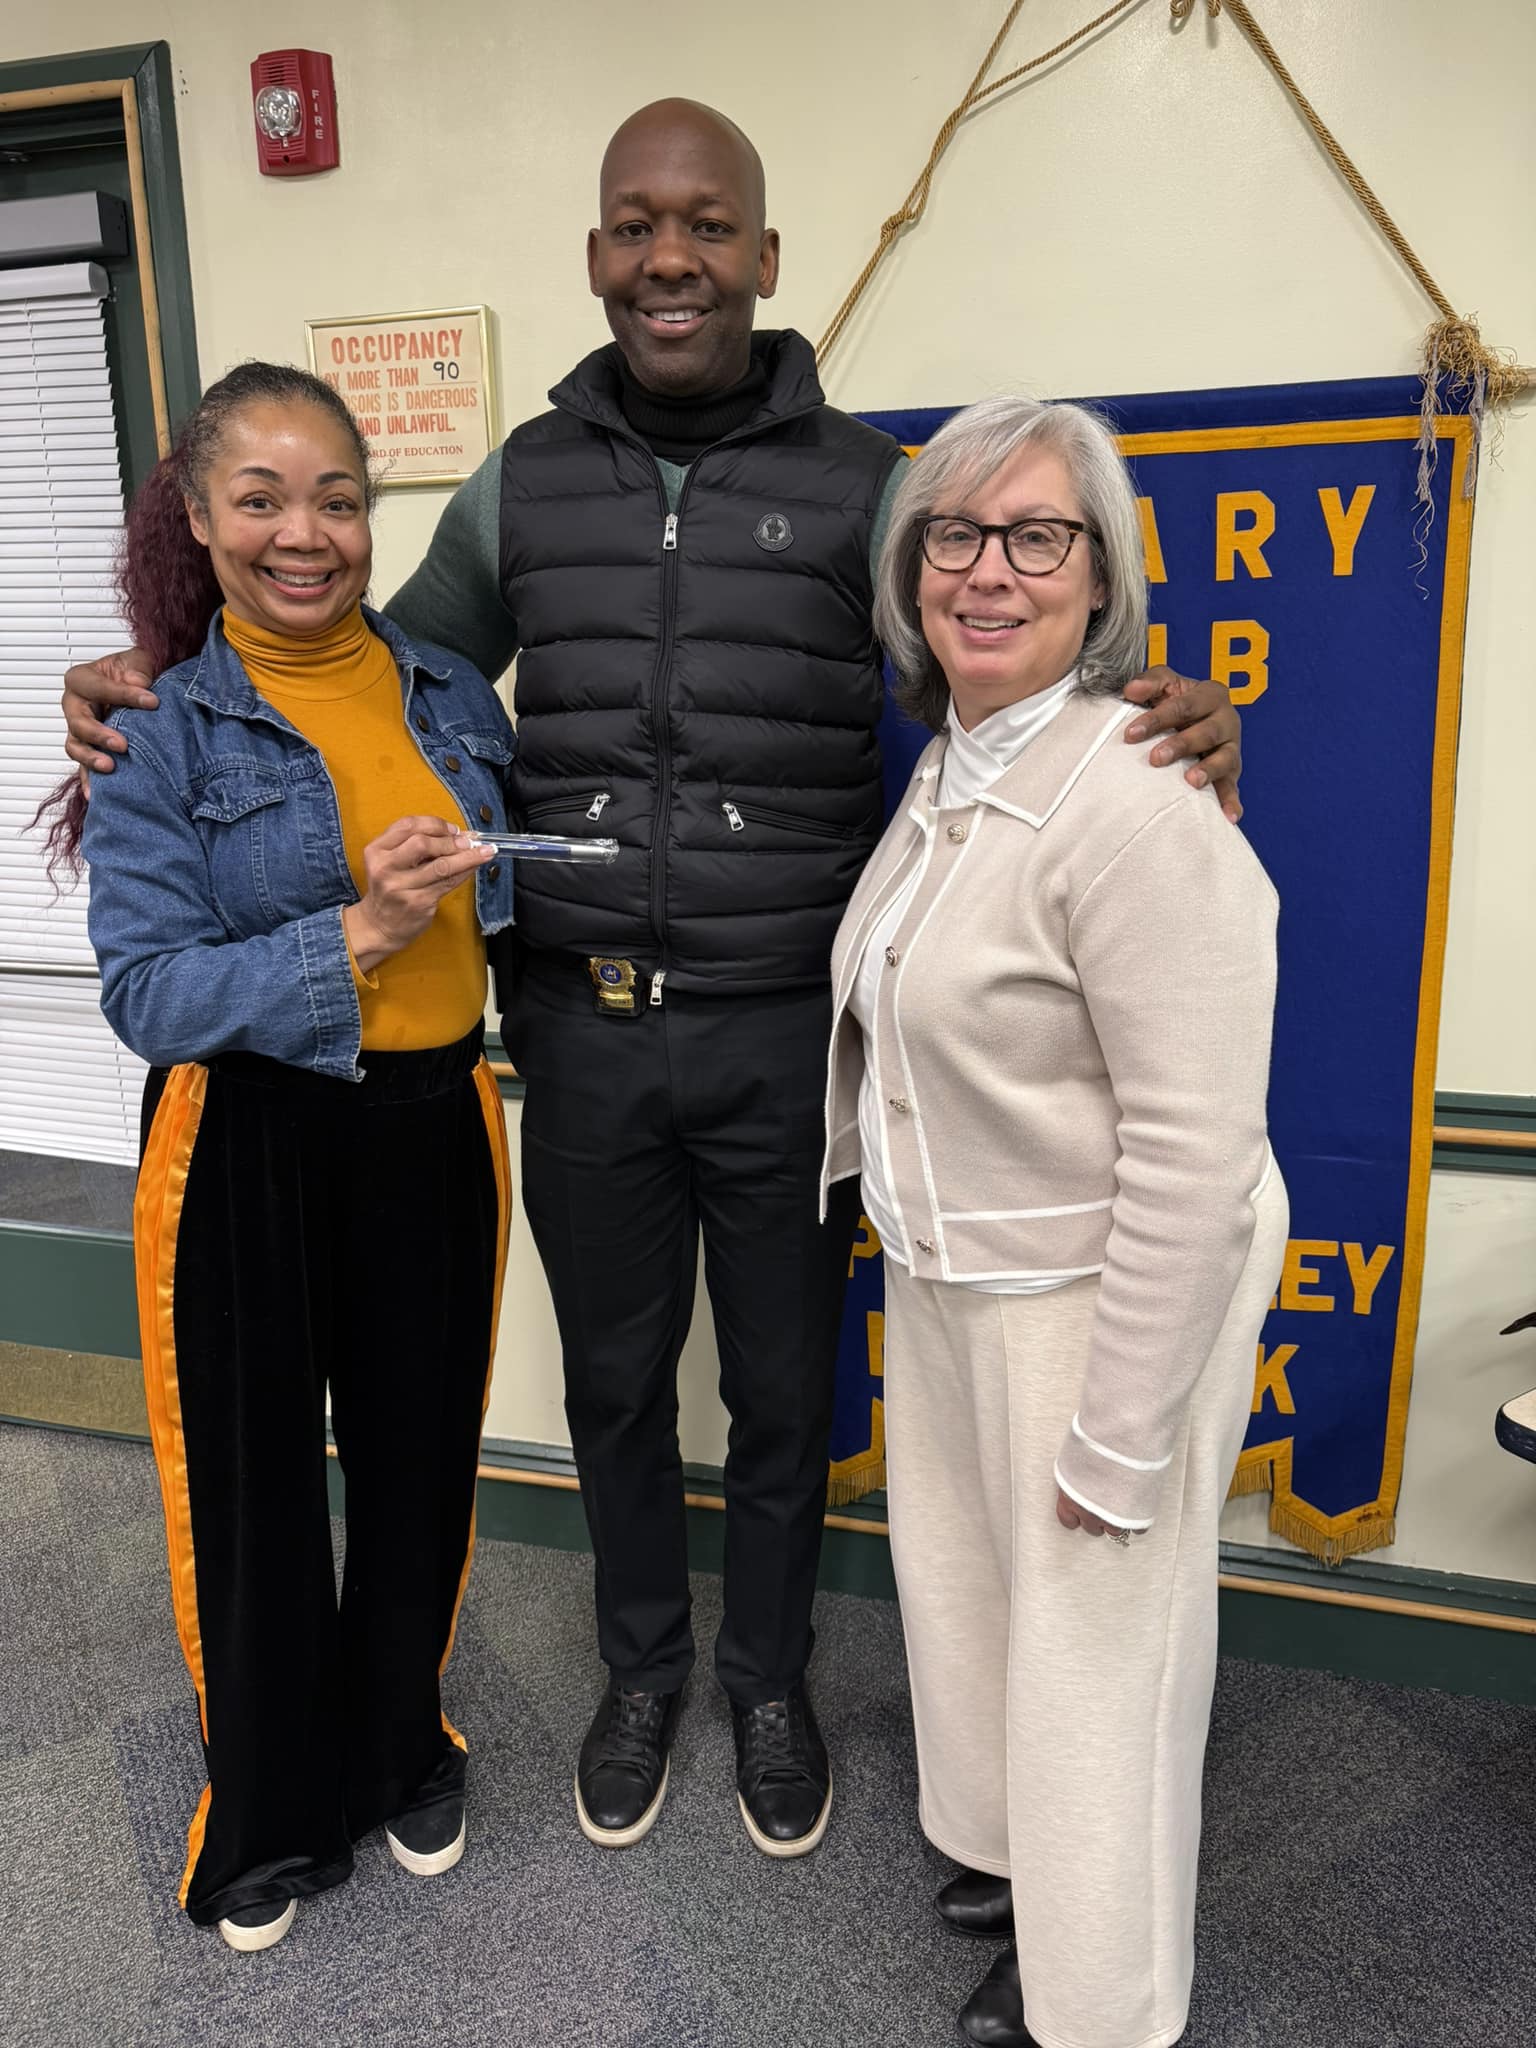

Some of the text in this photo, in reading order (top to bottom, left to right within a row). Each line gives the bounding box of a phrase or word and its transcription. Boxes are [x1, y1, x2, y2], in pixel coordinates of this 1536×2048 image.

[311, 89, 324, 140] FIRE
[331, 328, 463, 365] OCCUPANCY
[347, 369, 382, 391] MORE
[387, 367, 419, 388] THAN
[433, 361, 460, 381] 90
[388, 391, 399, 413] IS
[406, 387, 477, 411] DANGEROUS
[387, 413, 456, 436] UNLAWFUL.
[389, 447, 402, 457] OF
[404, 445, 463, 457] EDUCATION
